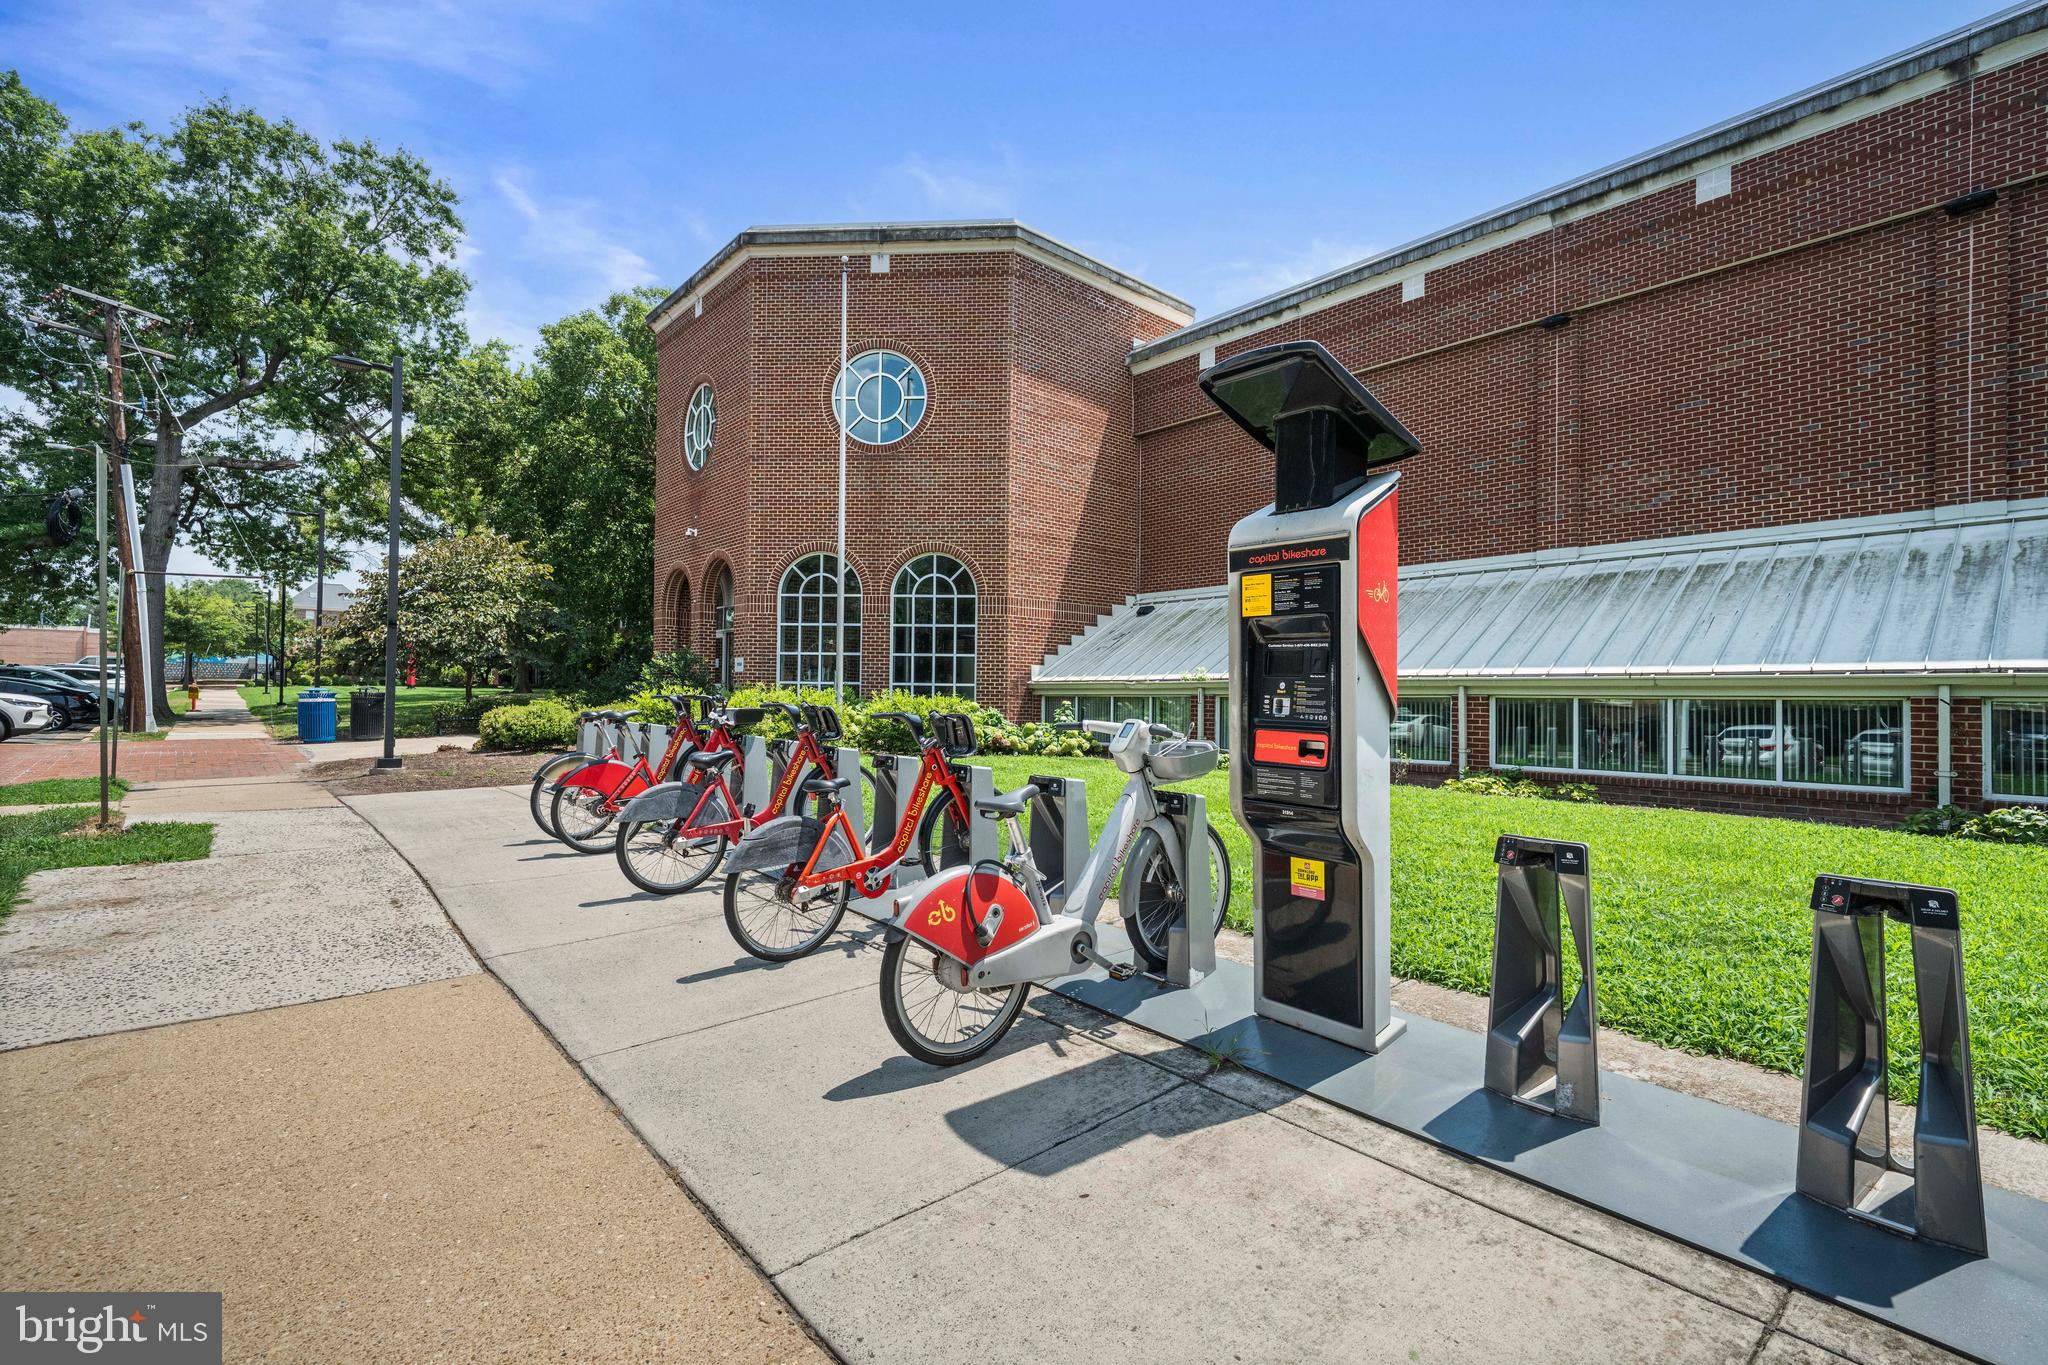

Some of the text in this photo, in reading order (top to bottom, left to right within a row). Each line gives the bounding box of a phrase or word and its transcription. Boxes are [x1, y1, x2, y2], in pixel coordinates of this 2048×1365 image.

[1248, 548, 1326, 564] capital bikeshare
[657, 730, 685, 780] capital bikeshare
[772, 750, 806, 814] capital bikeshare
[898, 772, 932, 853] capital bikeshare
[1098, 818, 1140, 900] capital bikeshare
